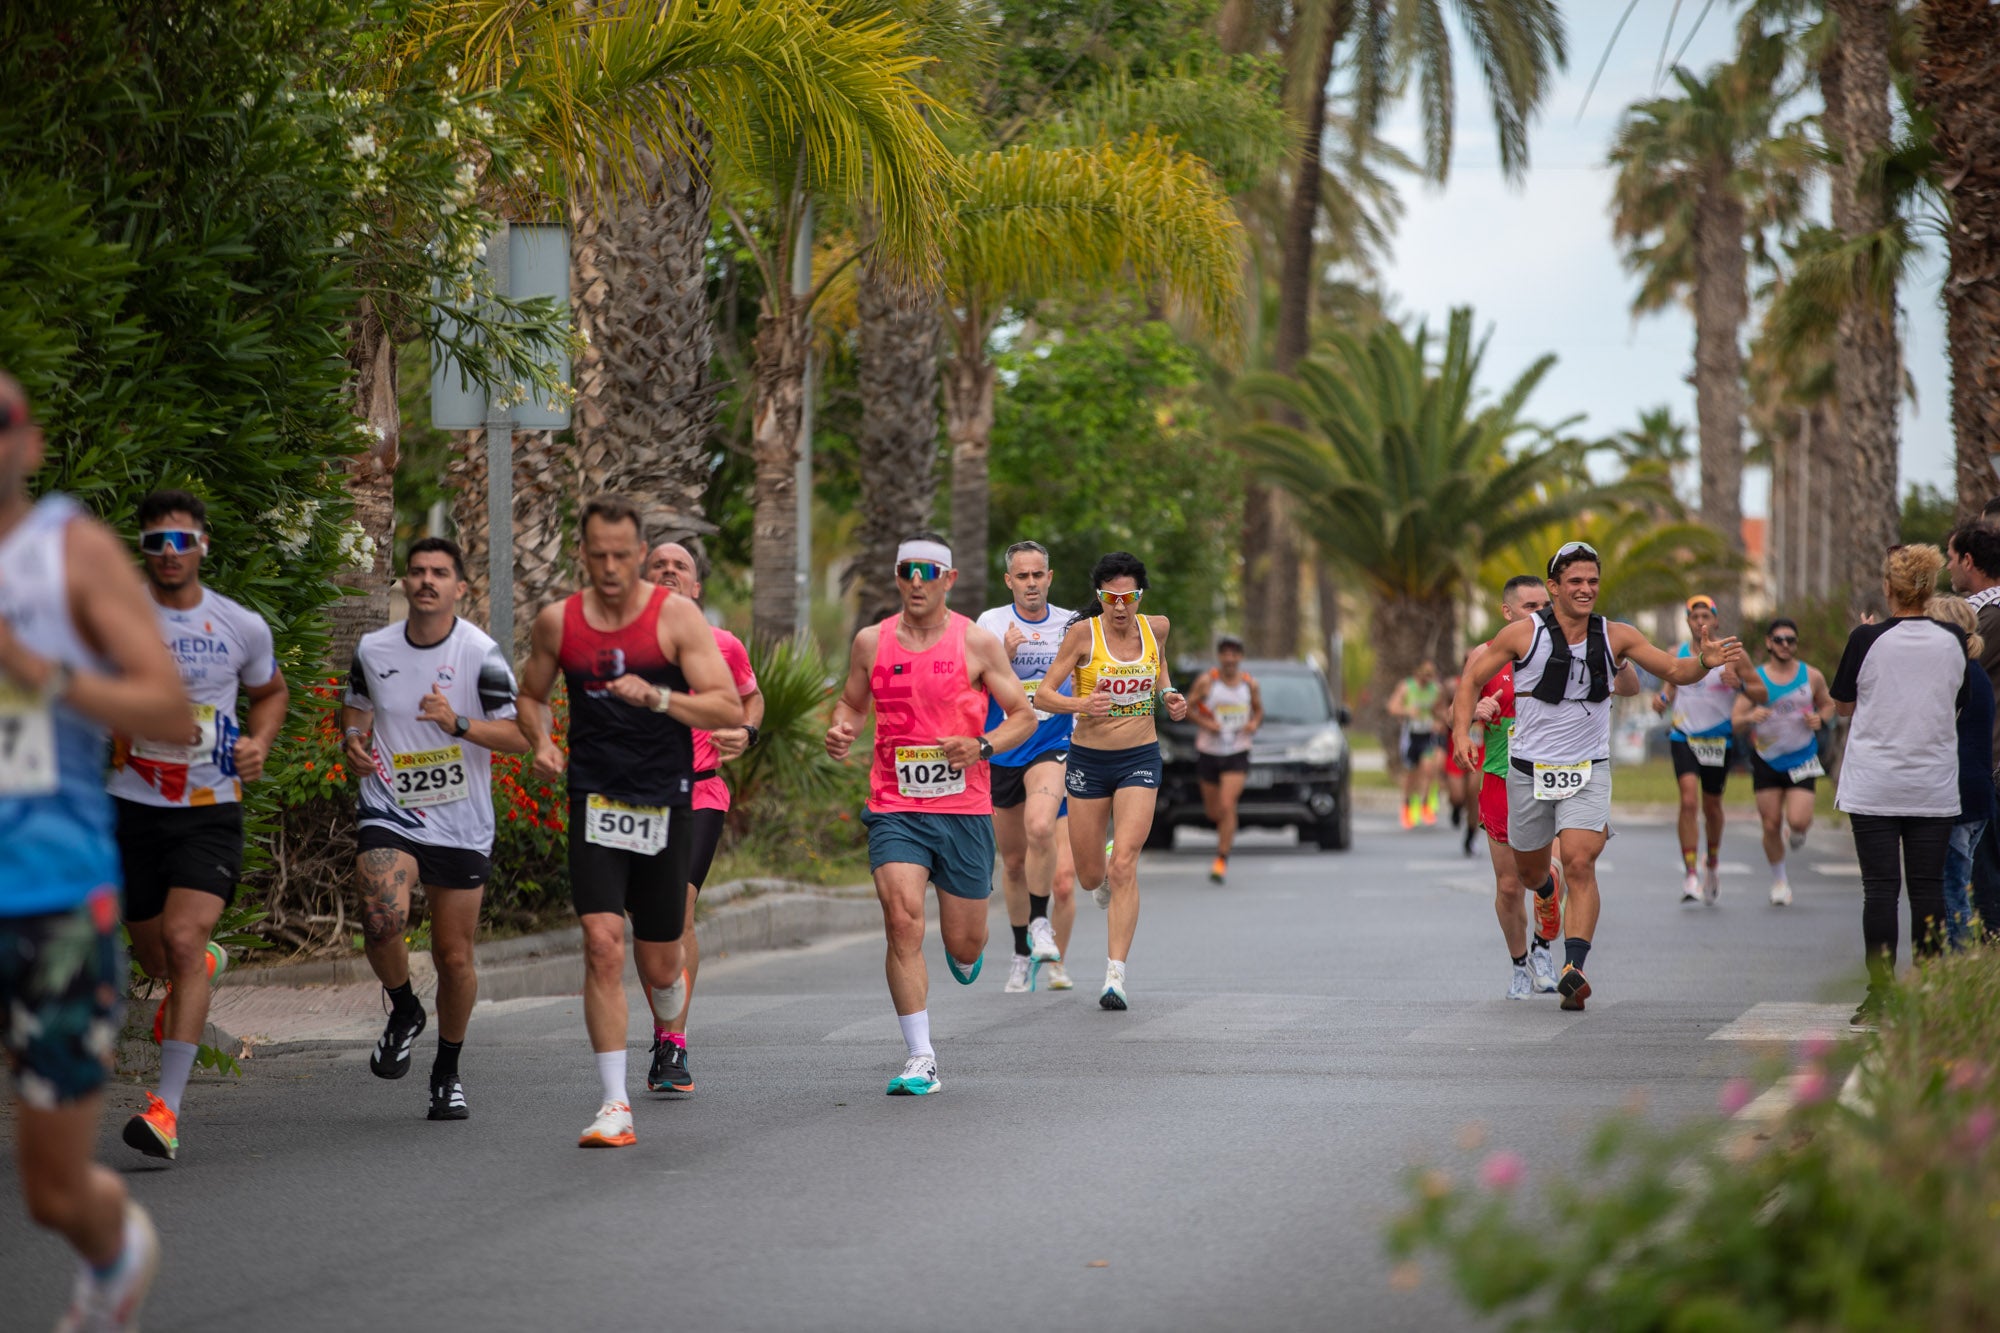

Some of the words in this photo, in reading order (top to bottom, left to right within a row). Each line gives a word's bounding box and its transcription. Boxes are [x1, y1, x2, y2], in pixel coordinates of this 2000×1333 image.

[933, 661, 954, 674] BCC
[1100, 678, 1153, 695] 2026
[396, 763, 465, 794] 3293
[899, 763, 963, 784] 1029
[1542, 771, 1584, 789] 939
[598, 812, 651, 840] 501
